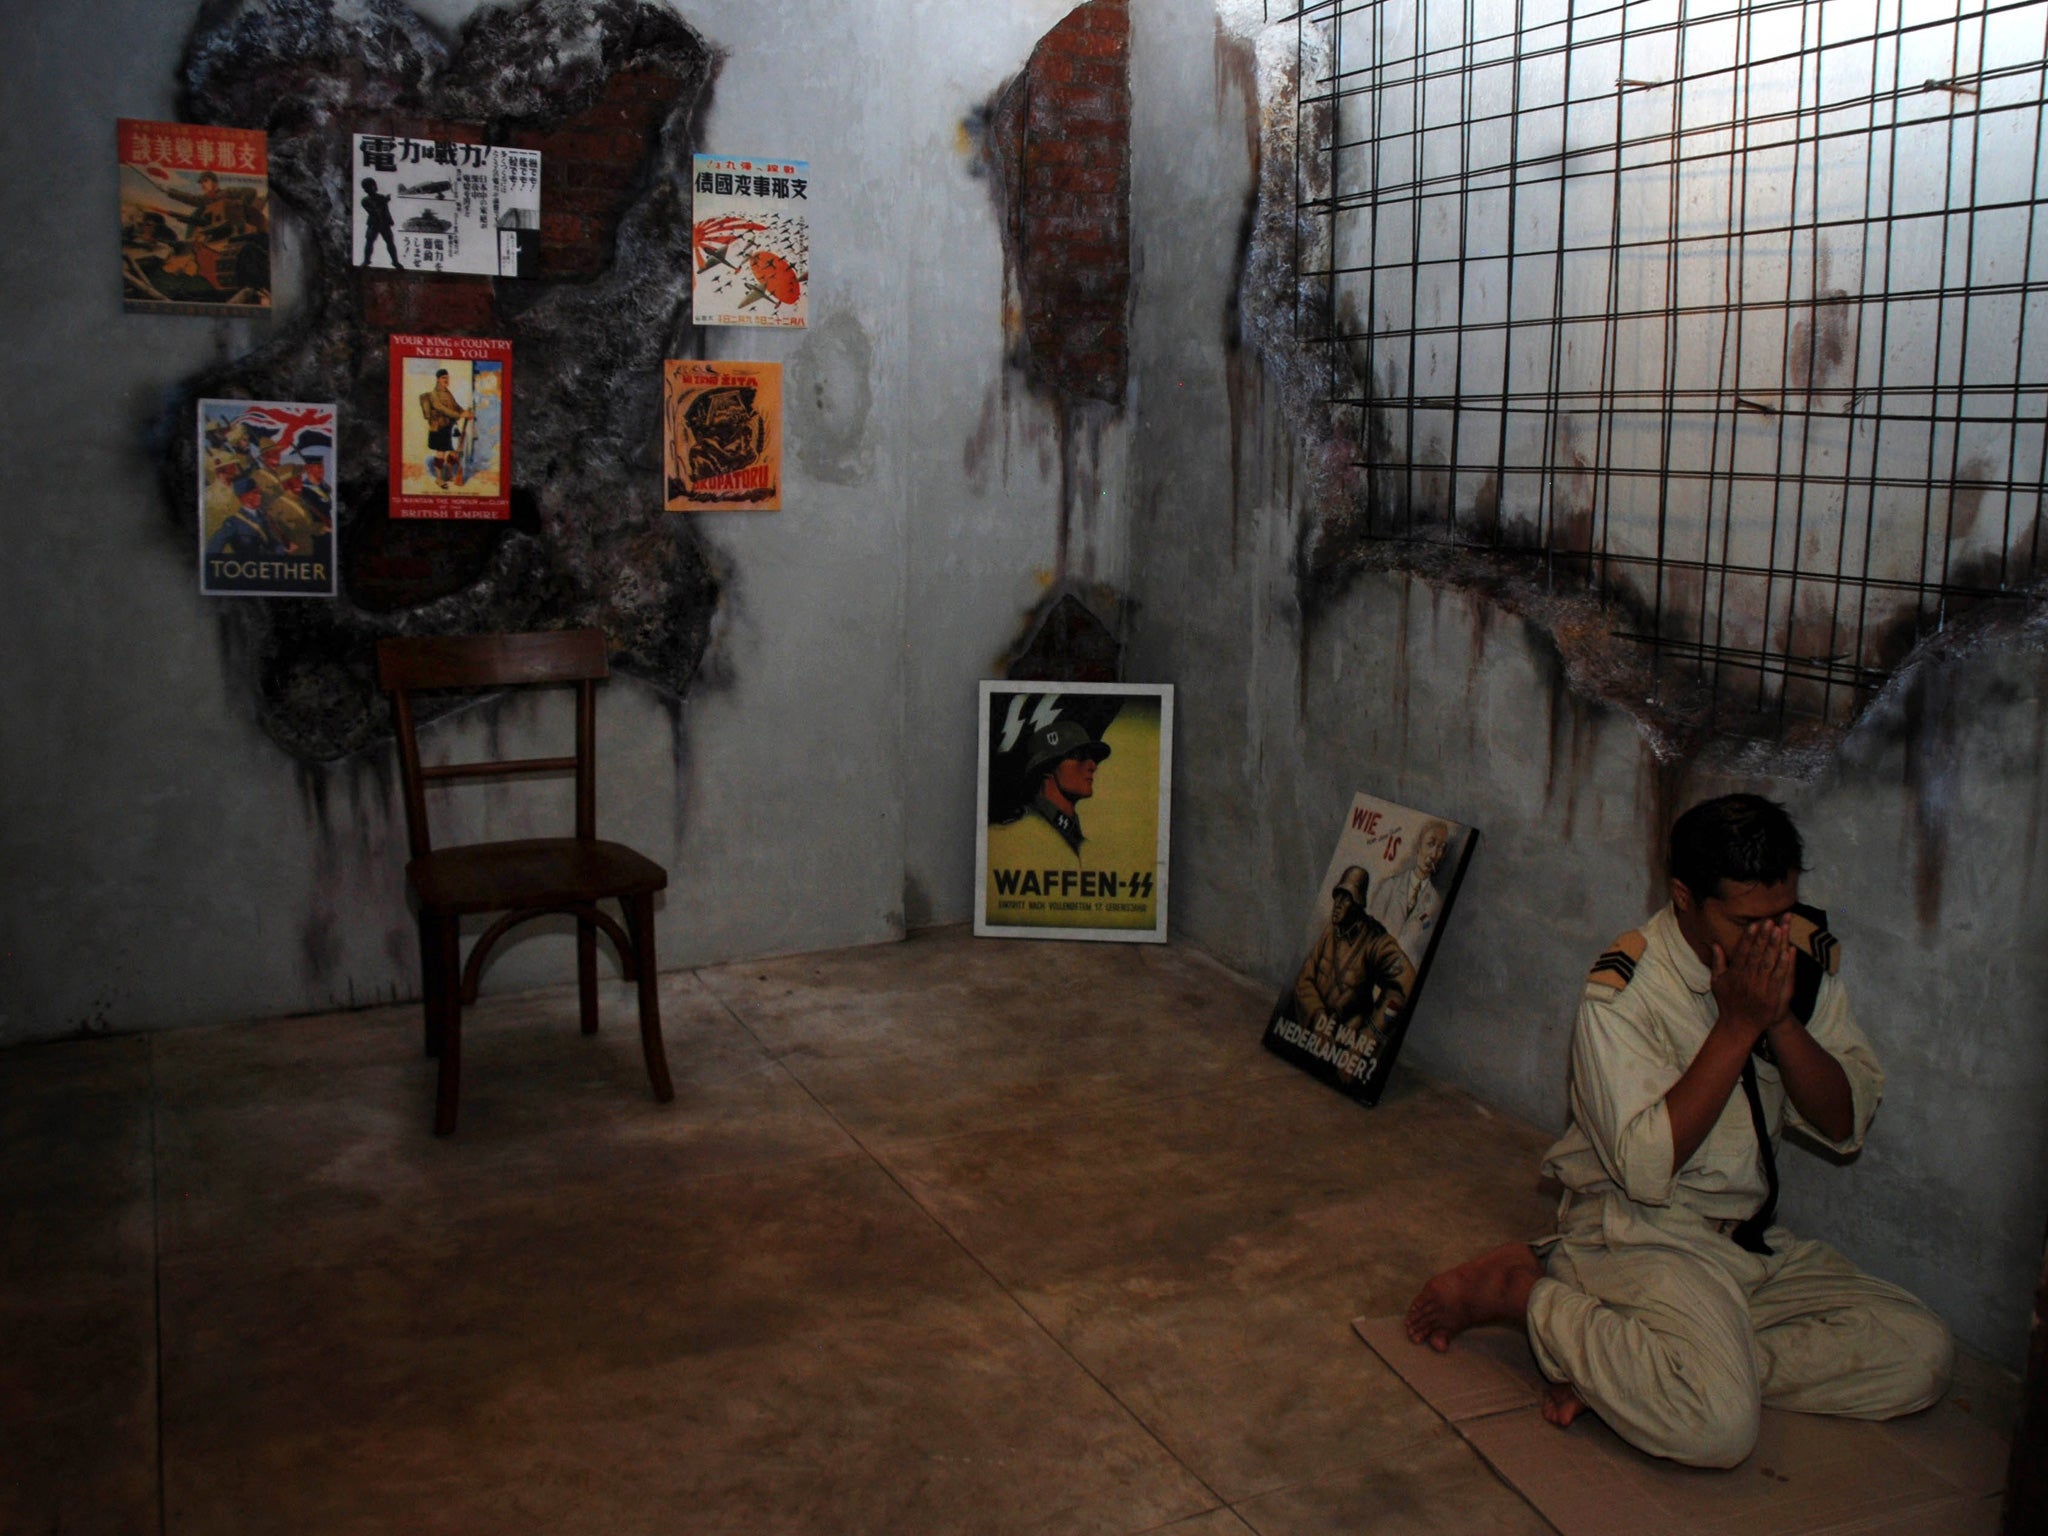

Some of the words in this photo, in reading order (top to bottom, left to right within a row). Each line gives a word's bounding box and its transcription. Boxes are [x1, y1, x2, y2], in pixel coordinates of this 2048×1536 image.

[392, 335, 423, 345] YOUR
[426, 337, 452, 347] KING
[460, 339, 512, 349] COUNTRY
[416, 347, 452, 356] NEED
[459, 348, 488, 357] YOU
[400, 509, 448, 518] BRITISH
[454, 510, 498, 519] EMPIRE
[209, 559, 325, 580] TOGETHER
[1352, 806, 1383, 835] WIE
[1383, 836, 1401, 861] IS
[1273, 1015, 1377, 1085] NEDERLANDER?
[1335, 1023, 1377, 1057] WARE
